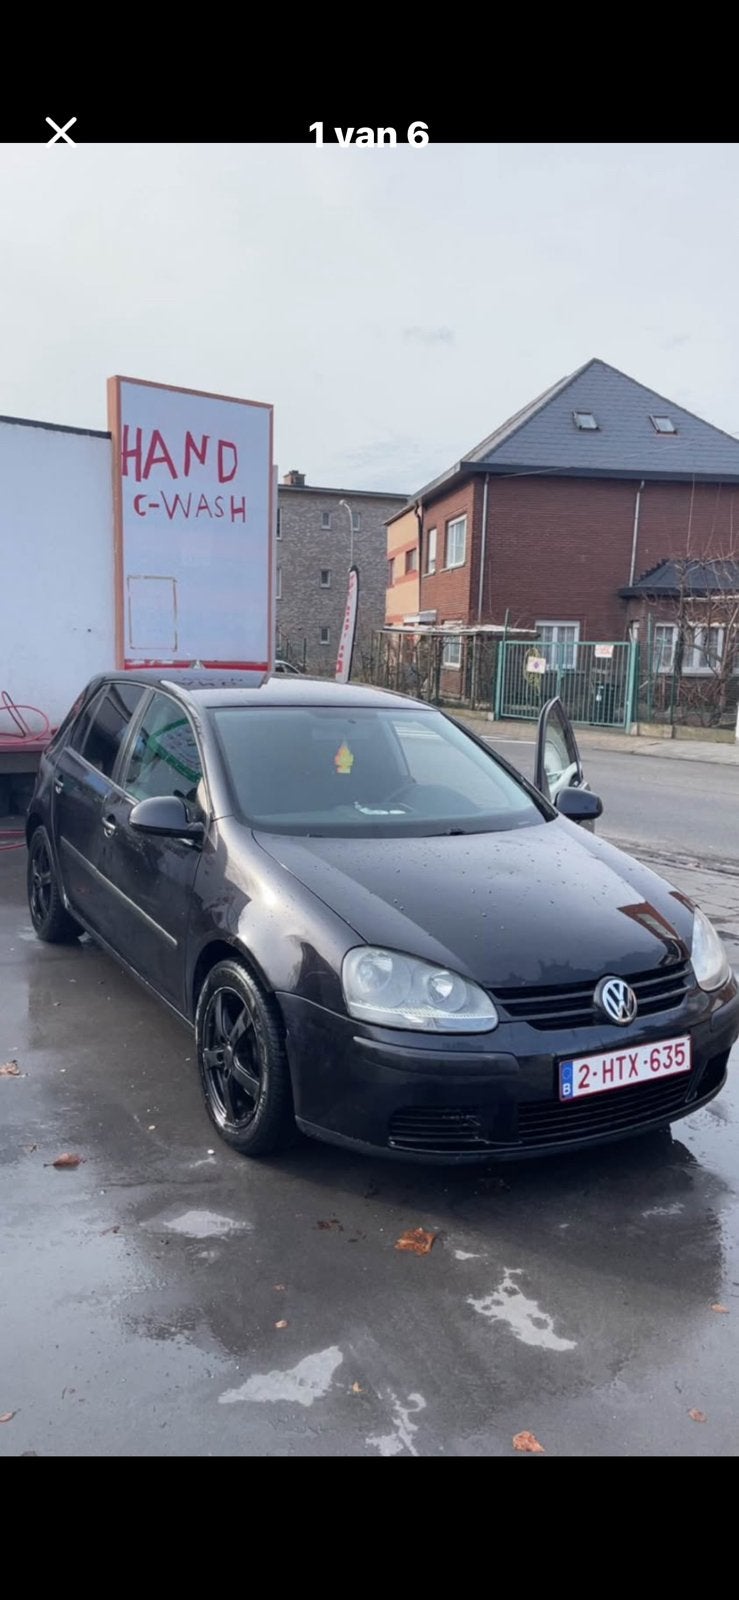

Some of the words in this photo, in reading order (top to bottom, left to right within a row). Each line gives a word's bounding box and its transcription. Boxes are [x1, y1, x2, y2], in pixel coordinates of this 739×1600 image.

[121, 425, 237, 483] HAND
[133, 491, 246, 522] C-WASH
[562, 1083, 571, 1096] B
